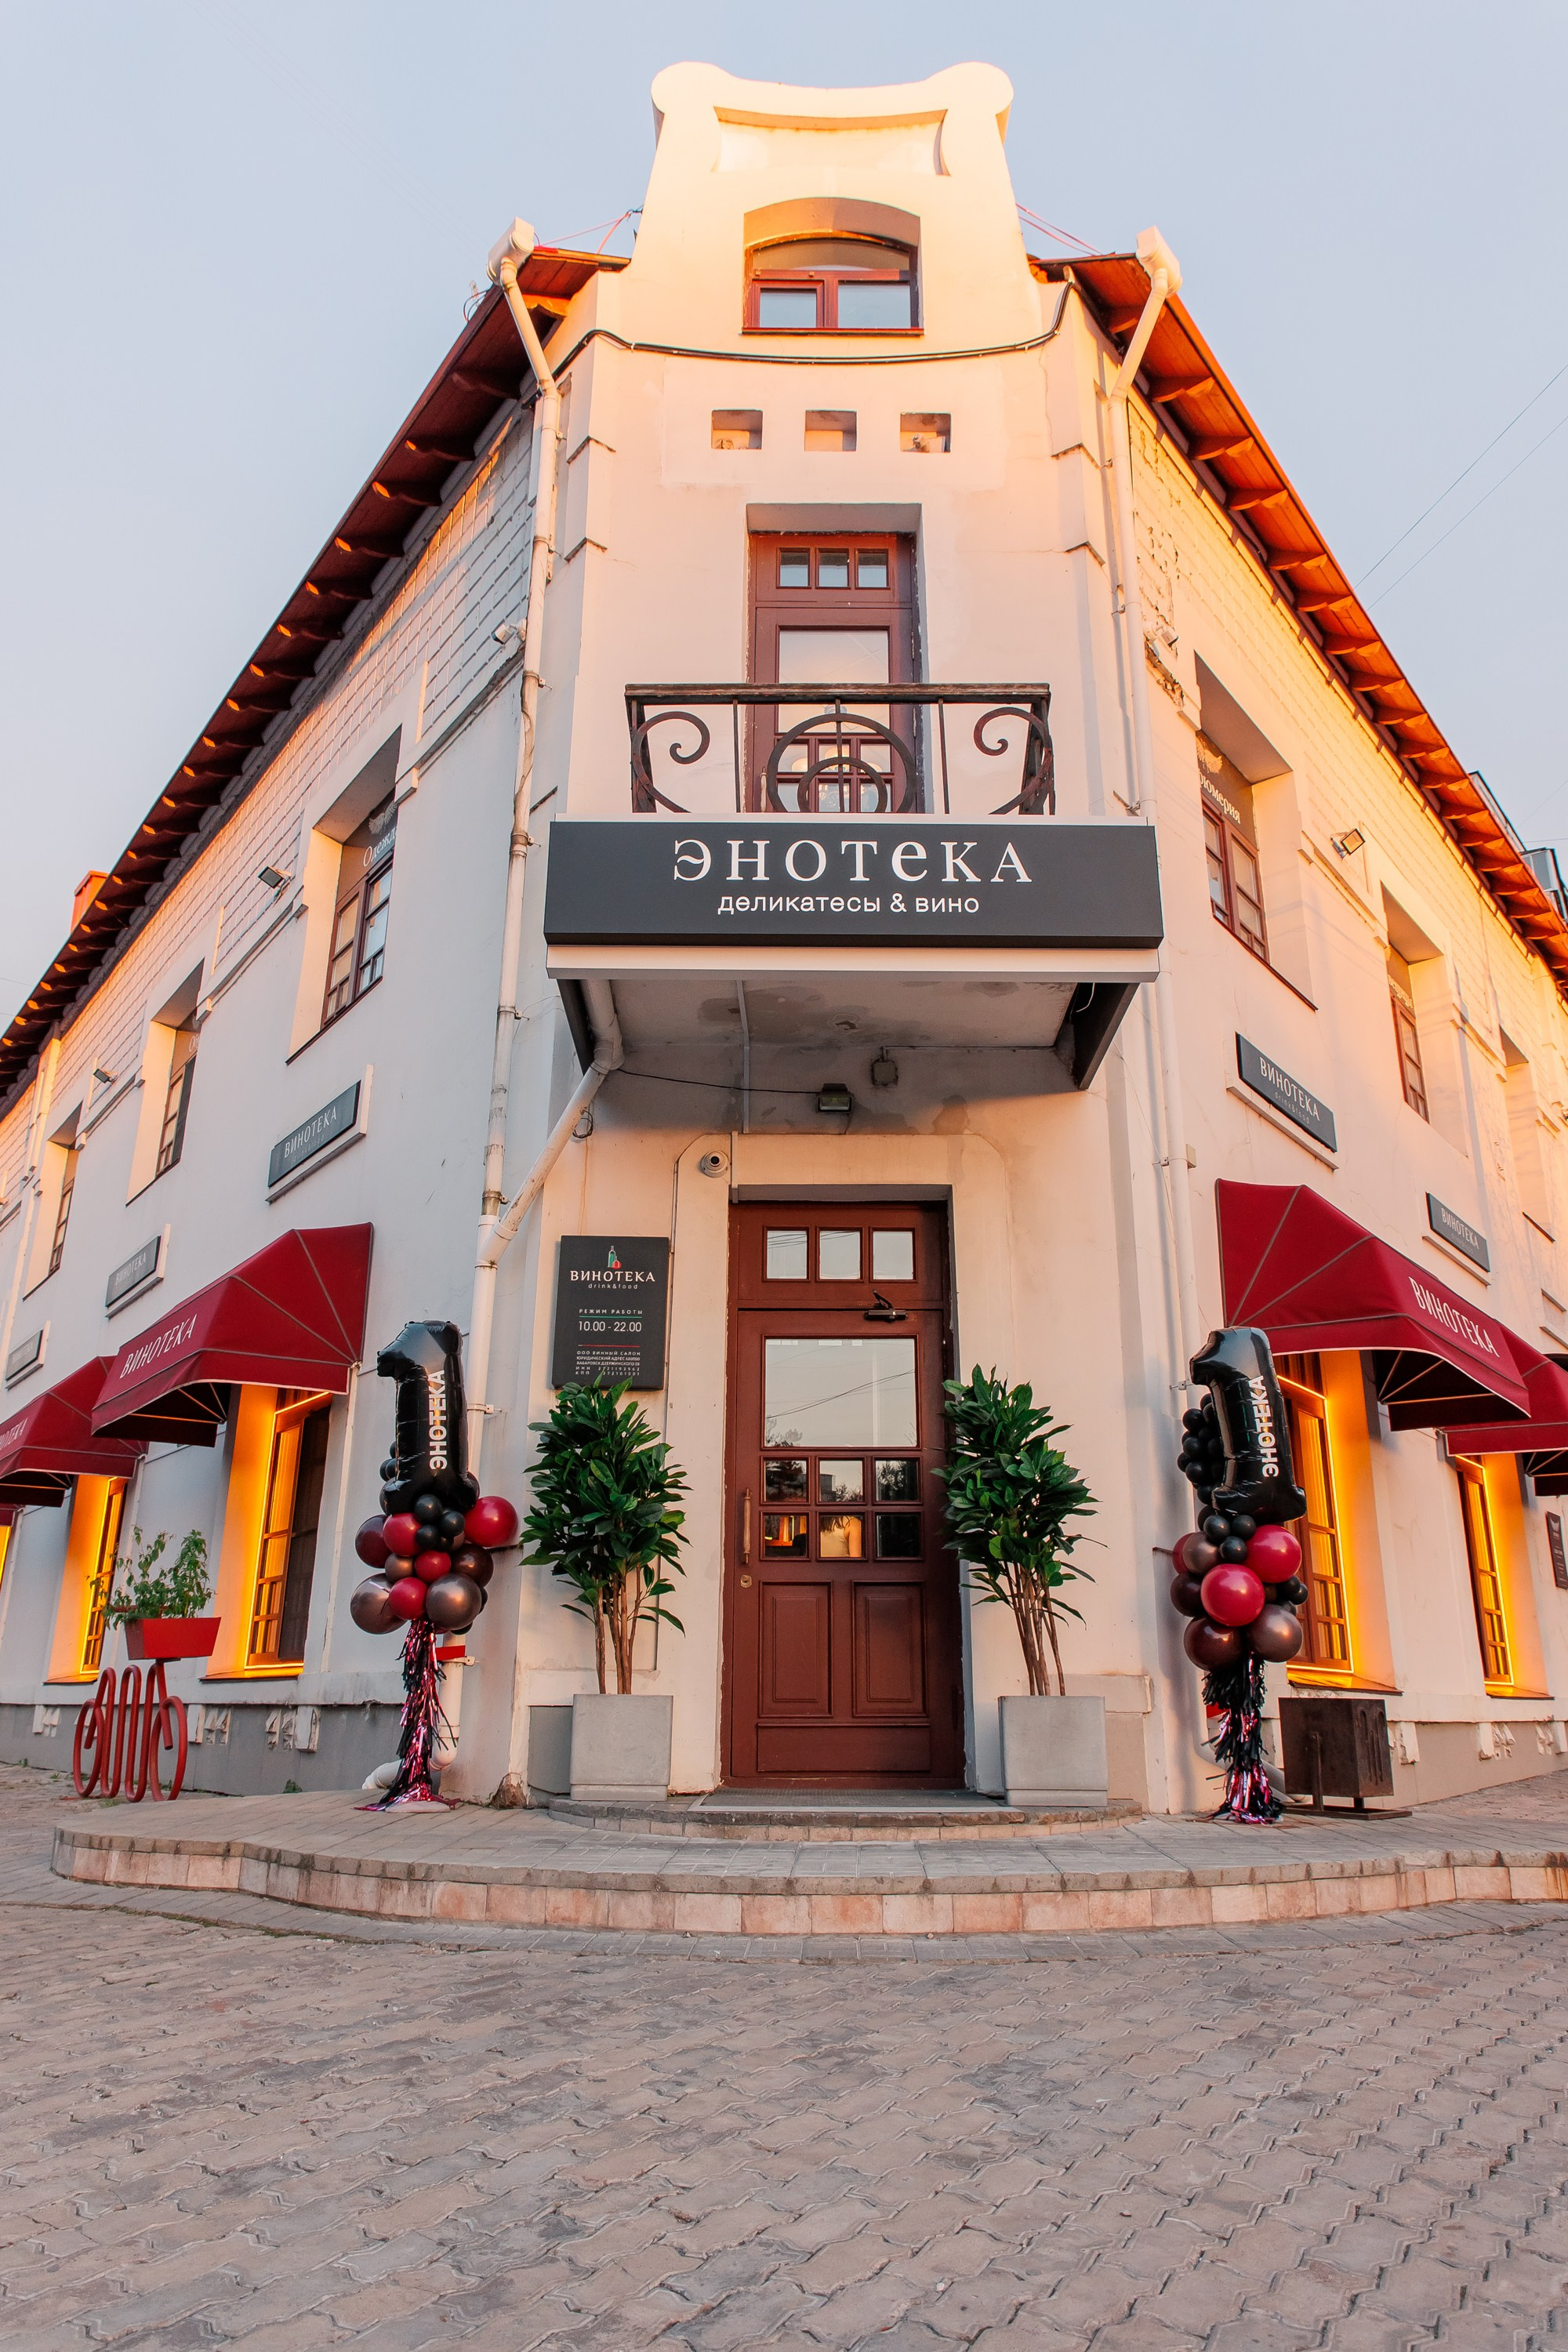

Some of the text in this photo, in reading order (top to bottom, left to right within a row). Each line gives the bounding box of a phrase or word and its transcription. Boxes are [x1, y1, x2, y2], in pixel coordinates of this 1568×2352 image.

[717, 892, 980, 915] деликатесы & вино
[1259, 1057, 1320, 1122] ВИНОТЕКА
[284, 1105, 337, 1159] ВИНОТЕКА
[1441, 1207, 1479, 1250] ВИНОТЕКА
[570, 1270, 656, 1283] ВИНОТЕКА
[119, 1313, 198, 1379] ВИНОТЕКА
[579, 1321, 606, 1332] 10.00
[613, 1322, 642, 1333] 22.00
[1408, 1276, 1501, 1358] ВИНОТЕКА
[428, 1370, 448, 1470] ЭНОТЕКА
[1248, 1375, 1279, 1478] ЭНОТЕКА
